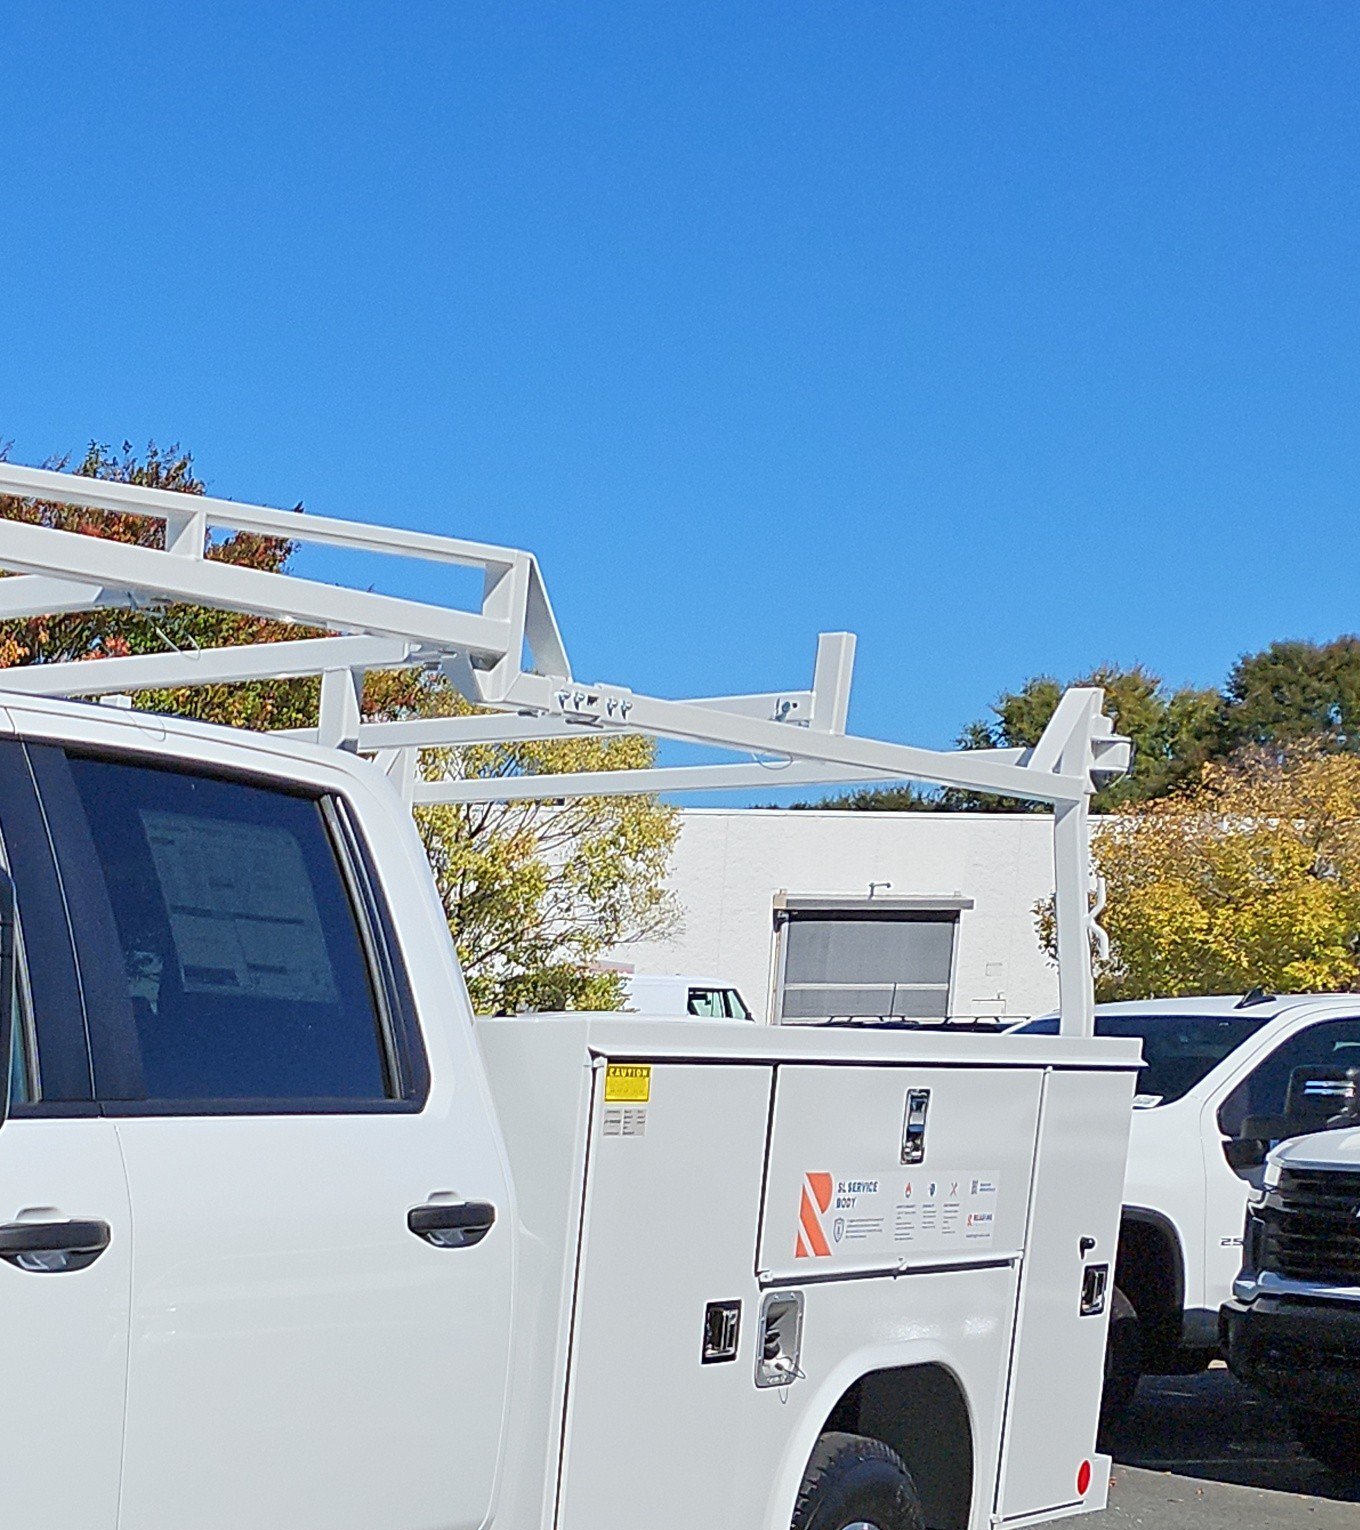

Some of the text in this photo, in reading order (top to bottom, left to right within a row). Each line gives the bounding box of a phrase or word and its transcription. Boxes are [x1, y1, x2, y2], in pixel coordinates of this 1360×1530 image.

[608, 1067, 648, 1077] CAUTION
[848, 1181, 878, 1193] SERVICE
[837, 1197, 857, 1208] BODY
